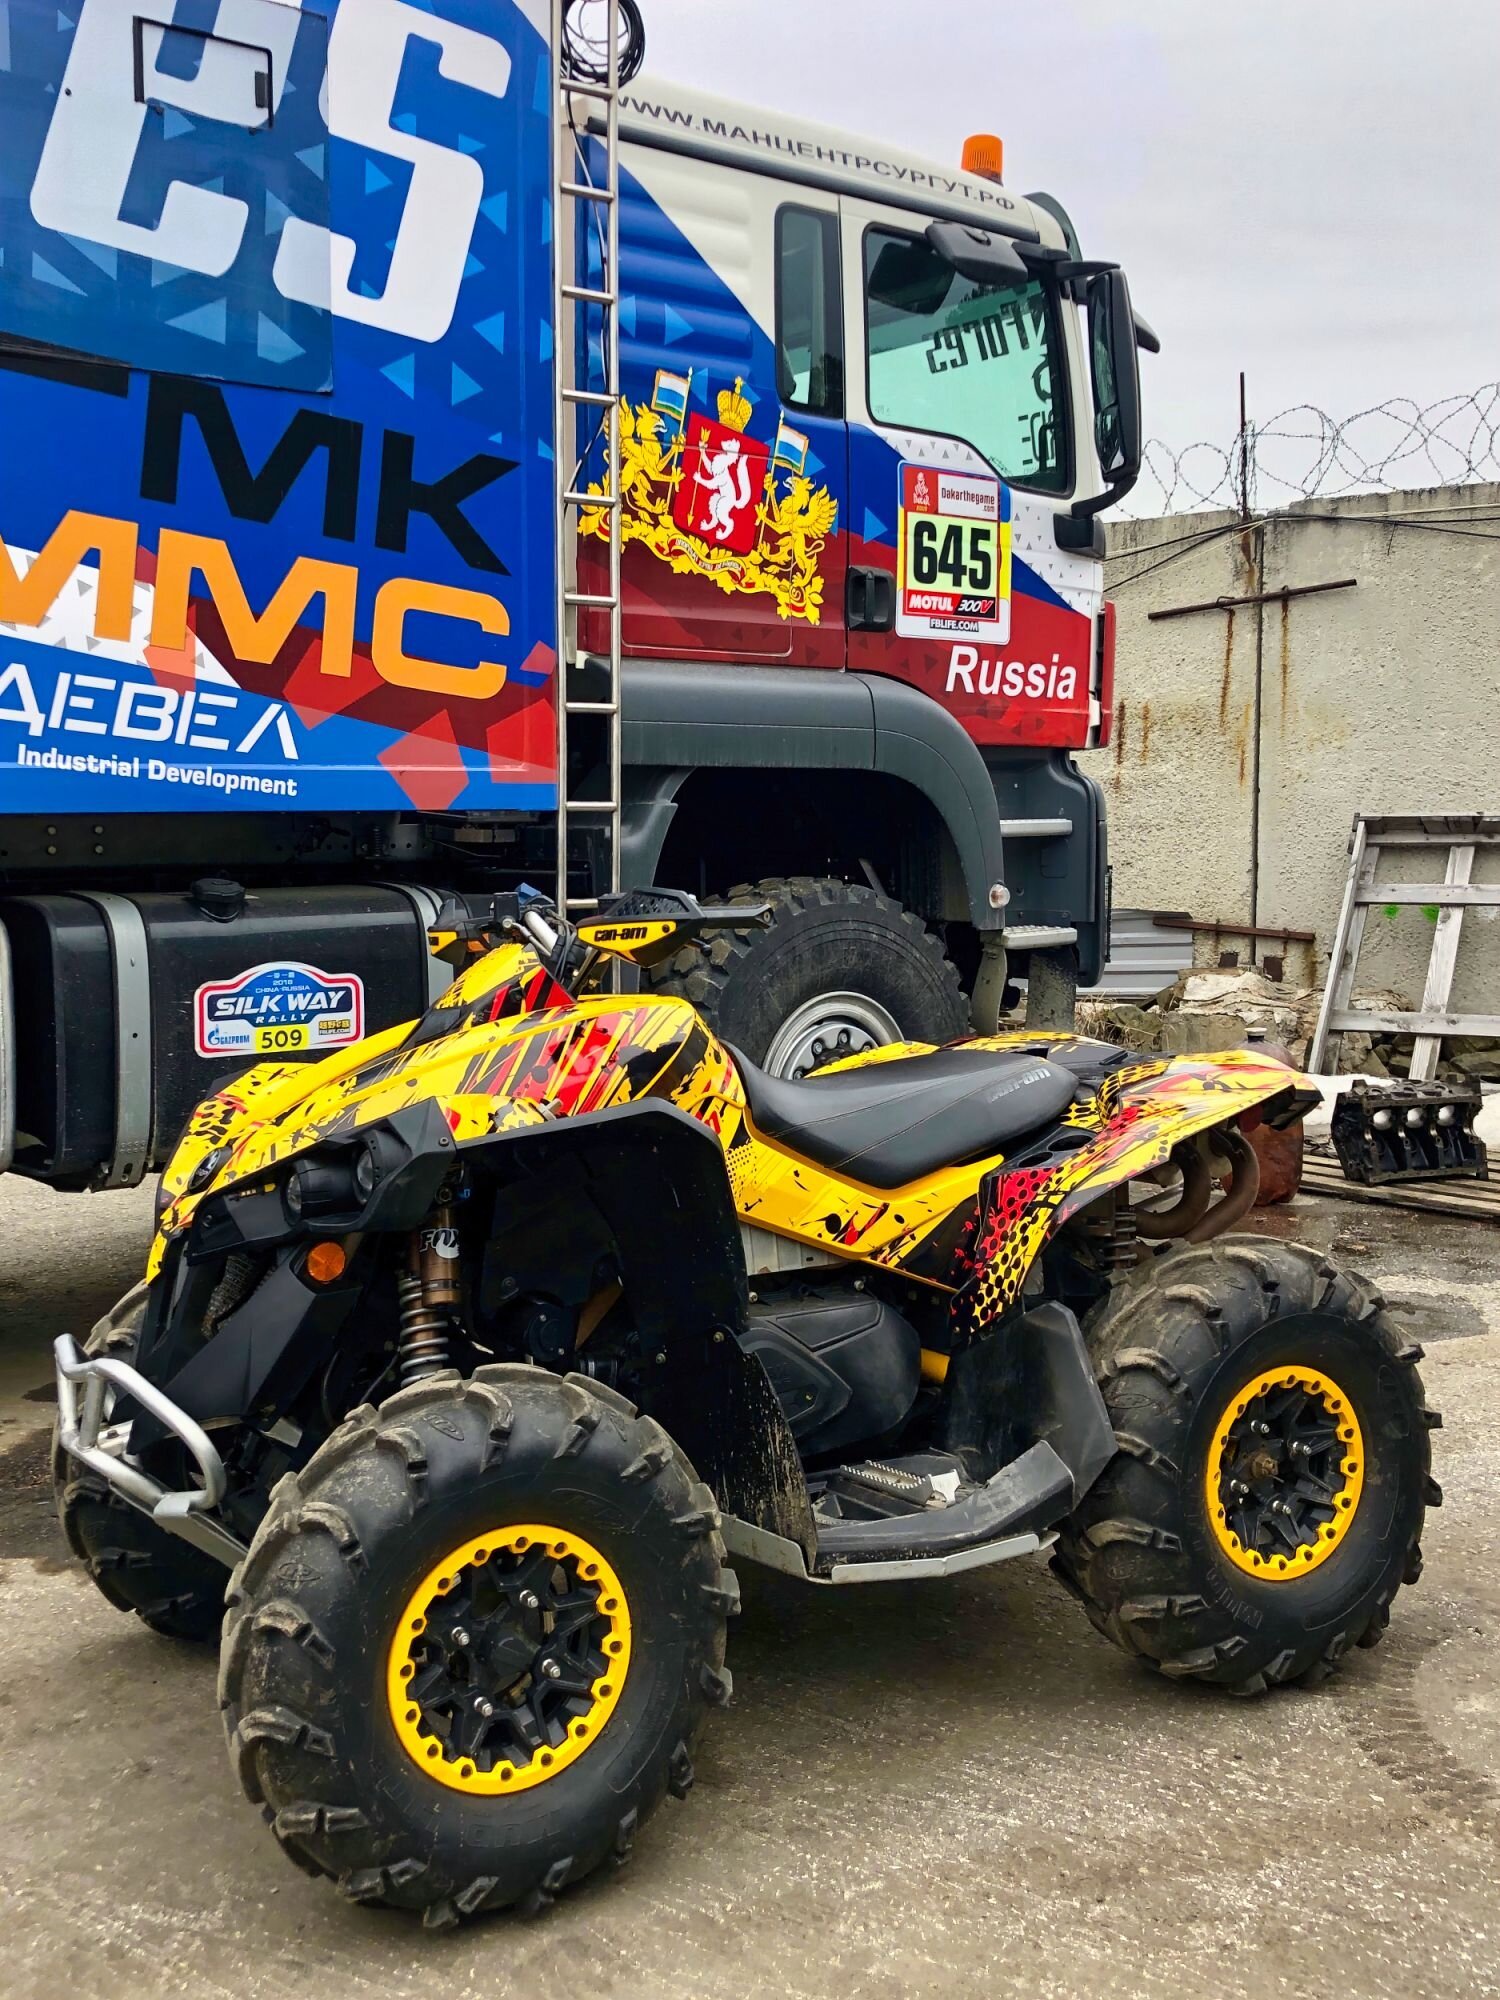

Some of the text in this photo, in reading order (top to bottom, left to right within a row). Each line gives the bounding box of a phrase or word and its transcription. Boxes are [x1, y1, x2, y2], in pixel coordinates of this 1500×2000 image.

[0, 363, 520, 577] МК
[941, 487, 995, 505] Dakarthegame
[913, 520, 992, 590] 645
[909, 594, 993, 614] MOTUL 300V
[930, 617, 979, 632] FBLIFE.COM
[944, 645, 1077, 700] Russia
[17, 743, 298, 796] Industrial Development
[214, 990, 347, 1017] SILK WAY
[255, 1013, 309, 1024] RALLY
[261, 1029, 302, 1049] 509
